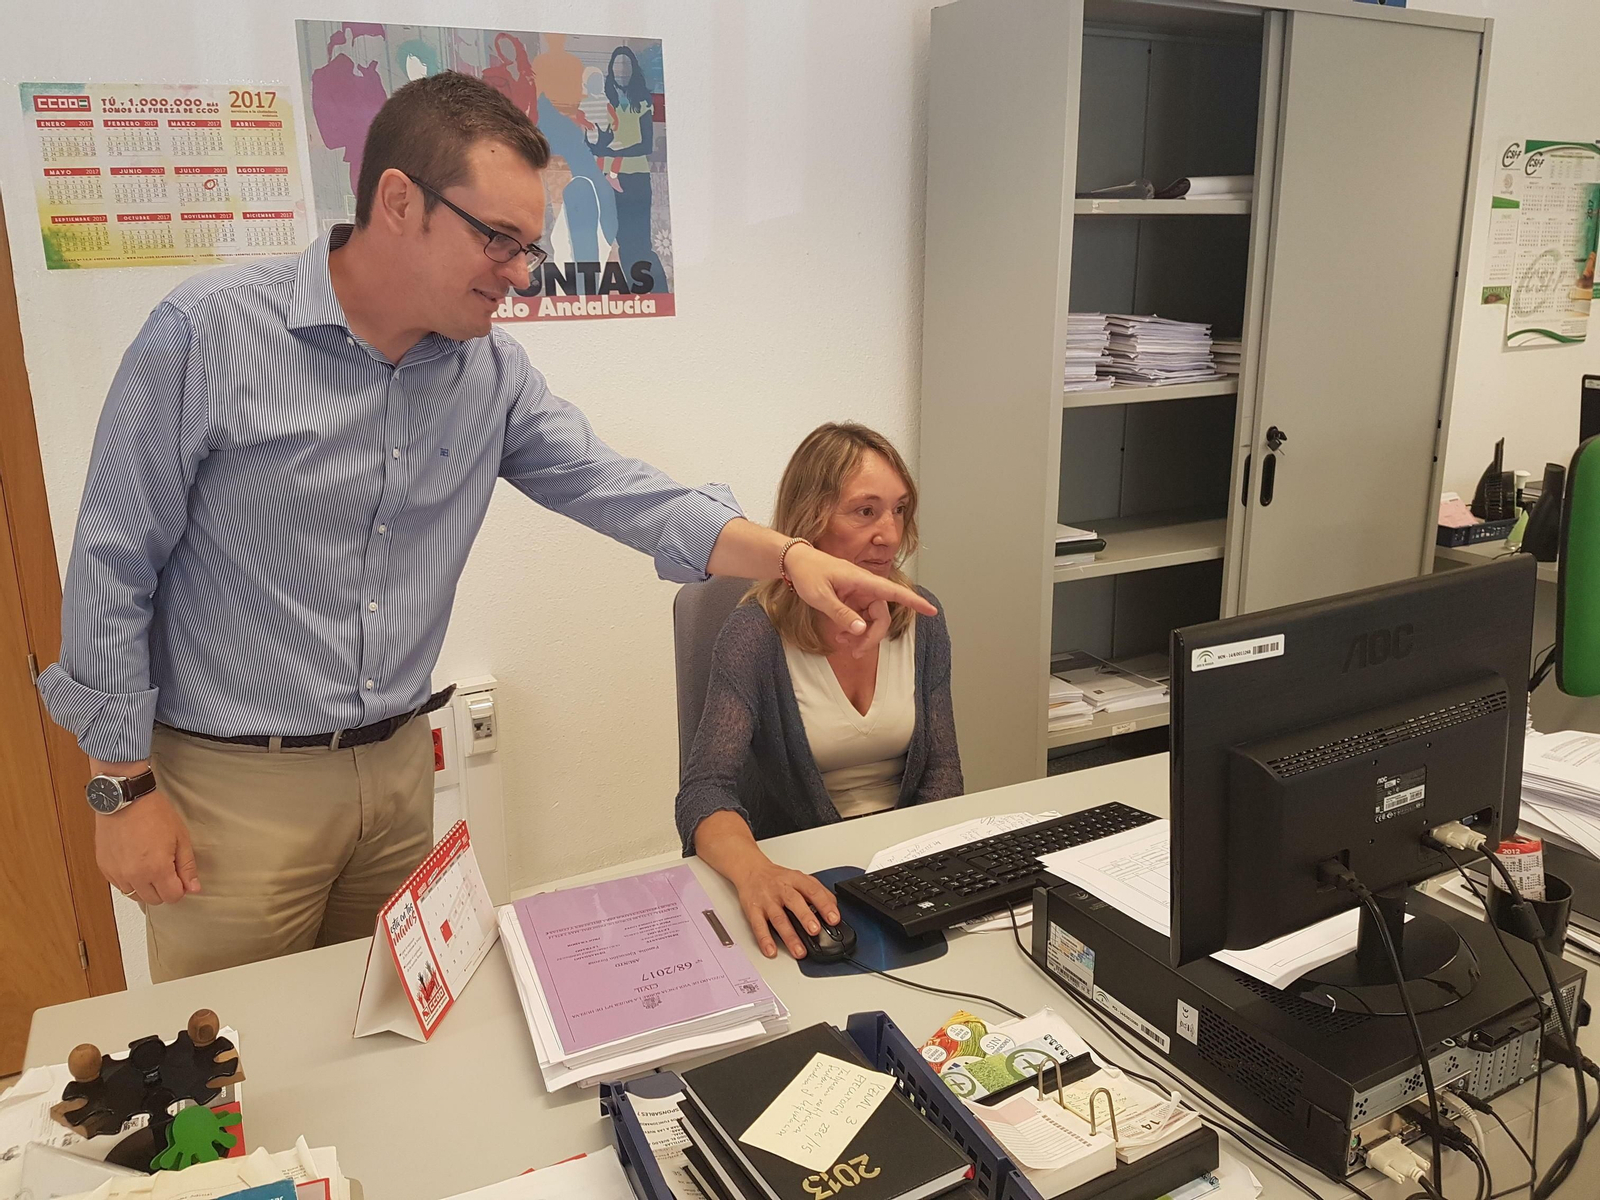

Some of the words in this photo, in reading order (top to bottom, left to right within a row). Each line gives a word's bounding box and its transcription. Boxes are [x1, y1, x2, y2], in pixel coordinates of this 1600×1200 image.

[37, 98, 78, 108] CCOO
[101, 96, 116, 106] TÚ
[128, 98, 202, 107] 1.000.000
[229, 90, 276, 108] 2017
[513, 260, 654, 297] UNTAS
[538, 295, 656, 317] Andalucía
[1342, 623, 1414, 674] AOC
[641, 961, 693, 981] 68/2017
[633, 983, 659, 993] CIVIL
[986, 1037, 1001, 1050] SIN
[856, 1082, 886, 1109] PENAL
[641, 1108, 679, 1117] SPONSABLES
[846, 1116, 857, 1126] 3
[1141, 1119, 1160, 1130] 14
[802, 1153, 882, 1200] 2013
